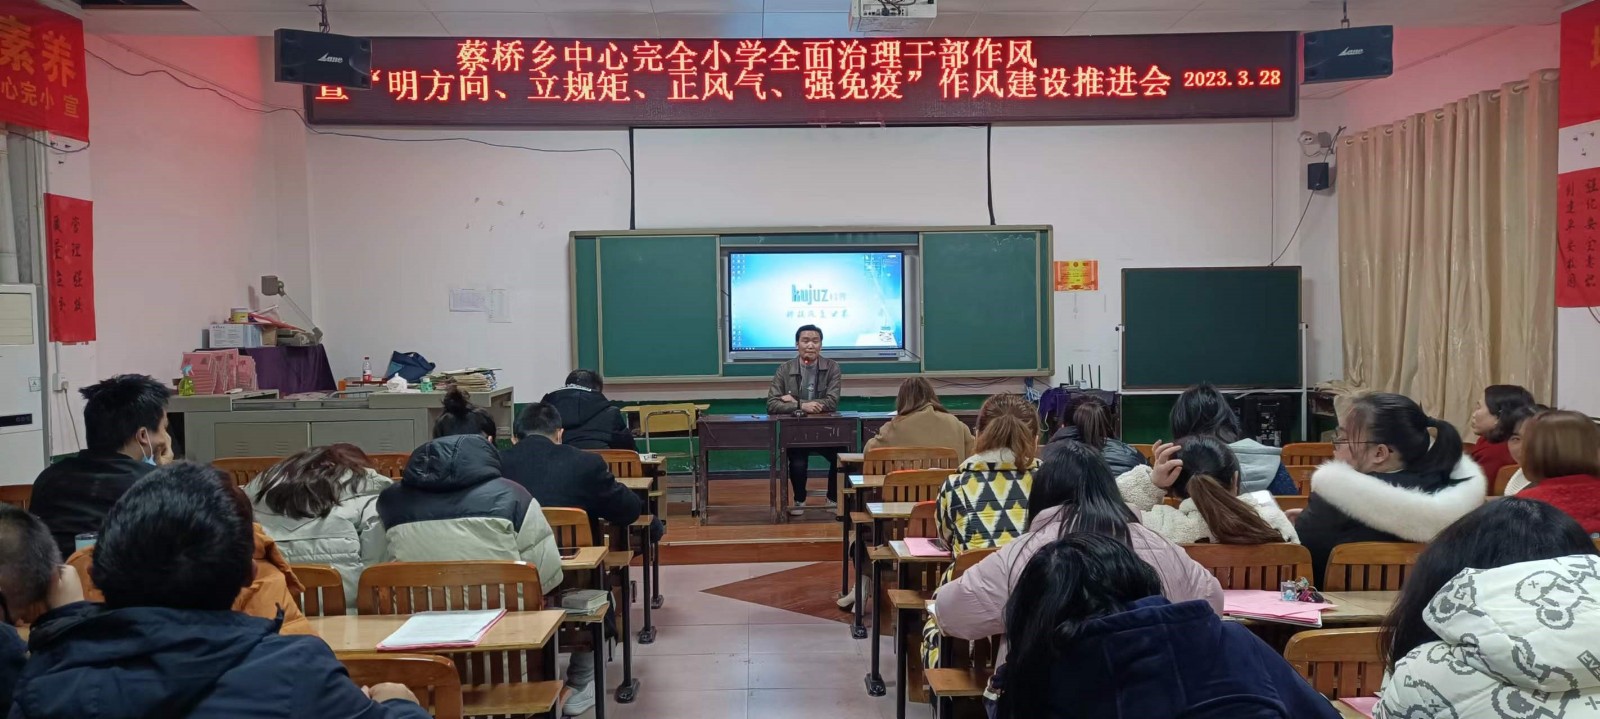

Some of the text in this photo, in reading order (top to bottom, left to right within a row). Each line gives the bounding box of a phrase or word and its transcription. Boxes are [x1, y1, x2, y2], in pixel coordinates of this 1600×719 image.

[457, 38, 1038, 69] 蔡桥乡中心完全小学全面治理干部作风
[1184, 69, 1281, 87] 2023.3.28
[1, 76, 80, 119] 心完小 宣
[791, 283, 829, 305] kujuz
